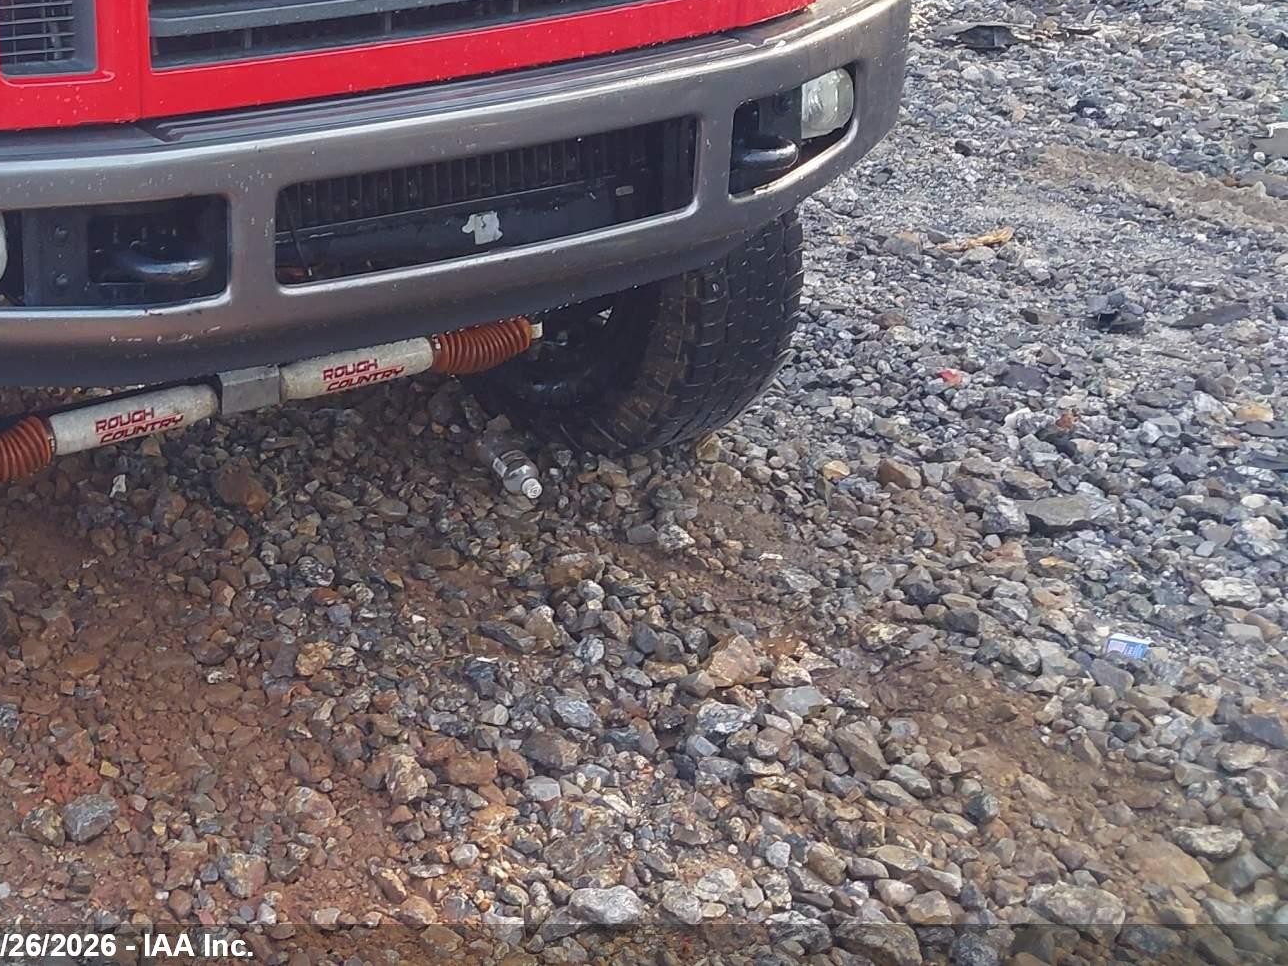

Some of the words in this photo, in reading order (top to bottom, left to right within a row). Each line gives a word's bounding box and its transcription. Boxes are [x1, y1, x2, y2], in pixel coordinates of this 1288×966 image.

[323, 358, 378, 381] ROUGH
[327, 366, 405, 392] COUNTRY
[95, 407, 155, 433] ROUGH
[100, 414, 184, 444] COUNTRY
